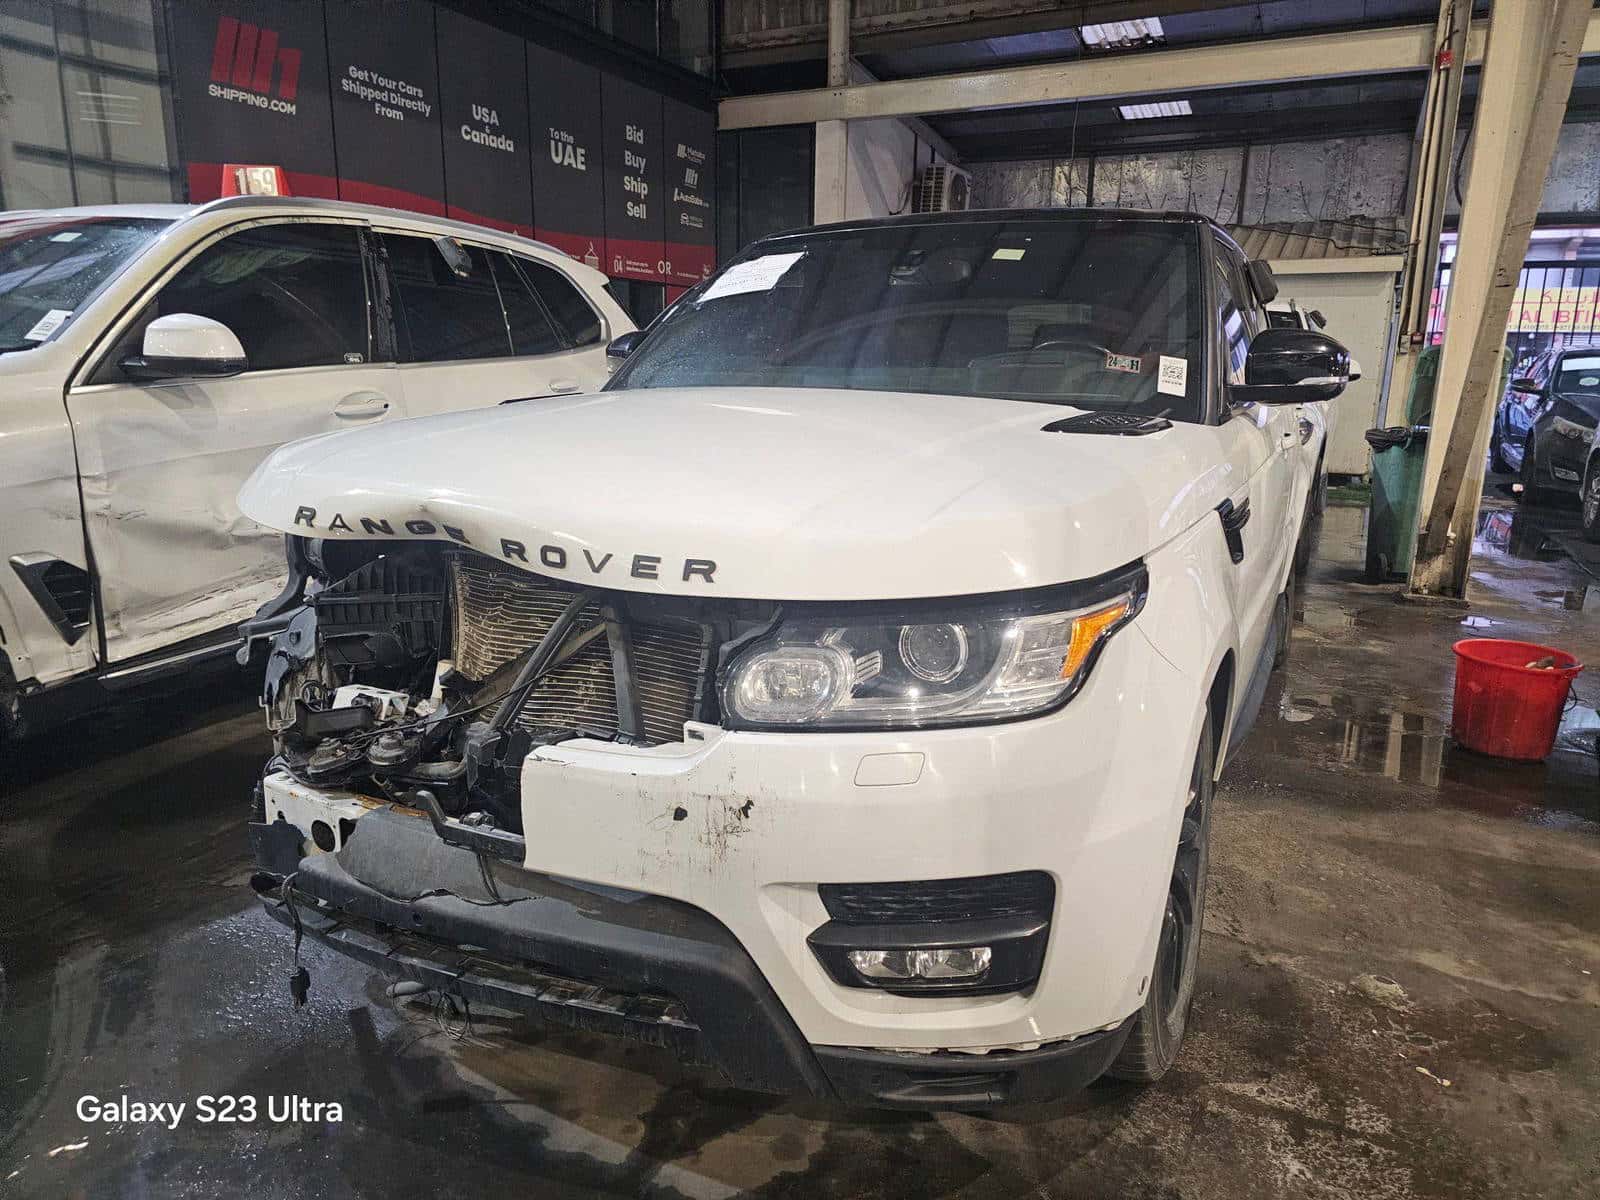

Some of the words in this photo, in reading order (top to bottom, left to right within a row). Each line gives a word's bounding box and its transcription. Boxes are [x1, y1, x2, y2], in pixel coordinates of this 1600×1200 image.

[348, 65, 369, 82] Get
[370, 71, 397, 90] Your
[398, 81, 424, 98] Cars
[208, 84, 296, 115] SHIPPING.COM
[341, 78, 389, 102] Shipped
[390, 92, 432, 118] Directly
[374, 102, 404, 121] From
[472, 103, 500, 127] USA
[461, 124, 515, 153] Canada
[549, 127, 560, 139] To
[560, 130, 574, 144] the
[625, 124, 644, 144] Bid
[550, 139, 586, 171] UAE
[624, 149, 647, 175] Buy
[623, 175, 649, 200] Ship
[626, 201, 647, 219] Sell
[657, 259, 672, 275] OR
[293, 505, 471, 545] RANGE
[500, 538, 717, 584] ROVER
